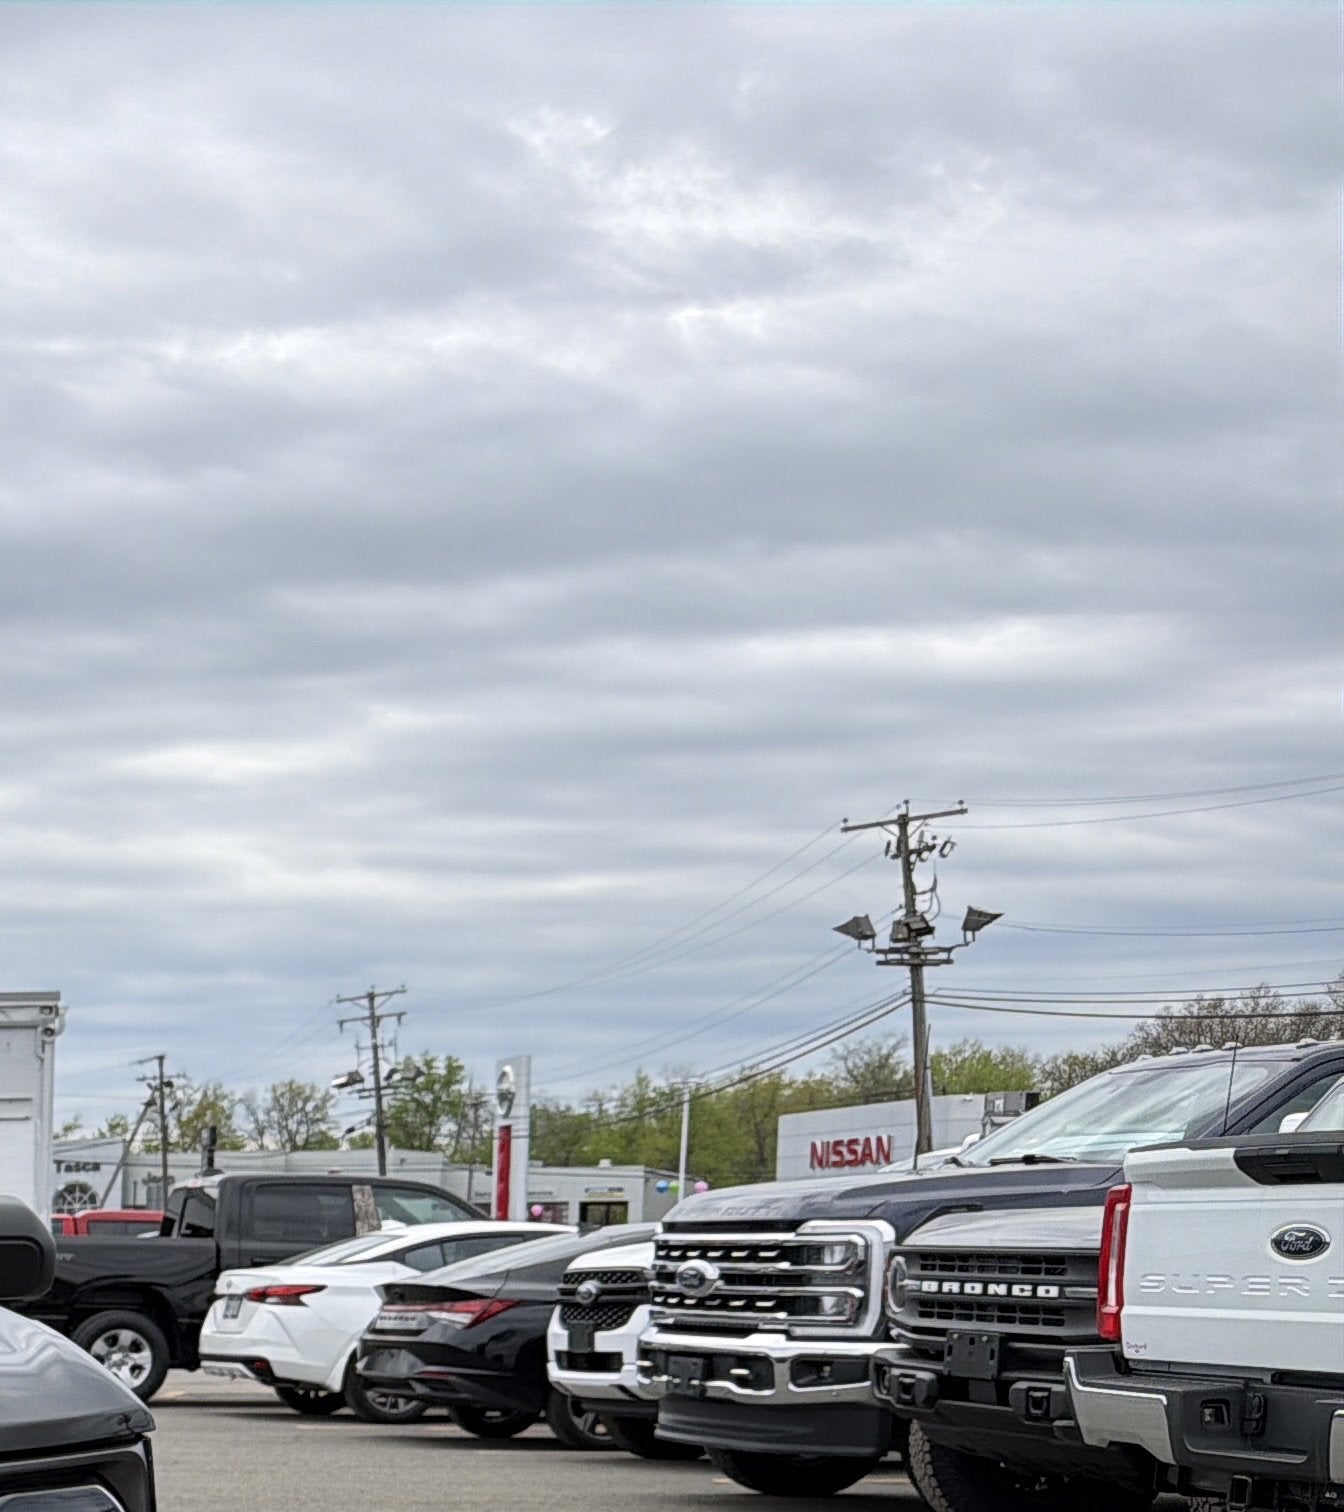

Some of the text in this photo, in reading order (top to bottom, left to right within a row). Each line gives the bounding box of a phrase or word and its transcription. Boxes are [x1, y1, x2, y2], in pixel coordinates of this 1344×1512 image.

[809, 1134, 892, 1170] NISSAN
[54, 1160, 101, 1173] Tasca
[1280, 1230, 1314, 1251] Ford
[921, 1280, 1060, 1298] BRONCO
[1140, 1273, 1311, 1297] SUPER
